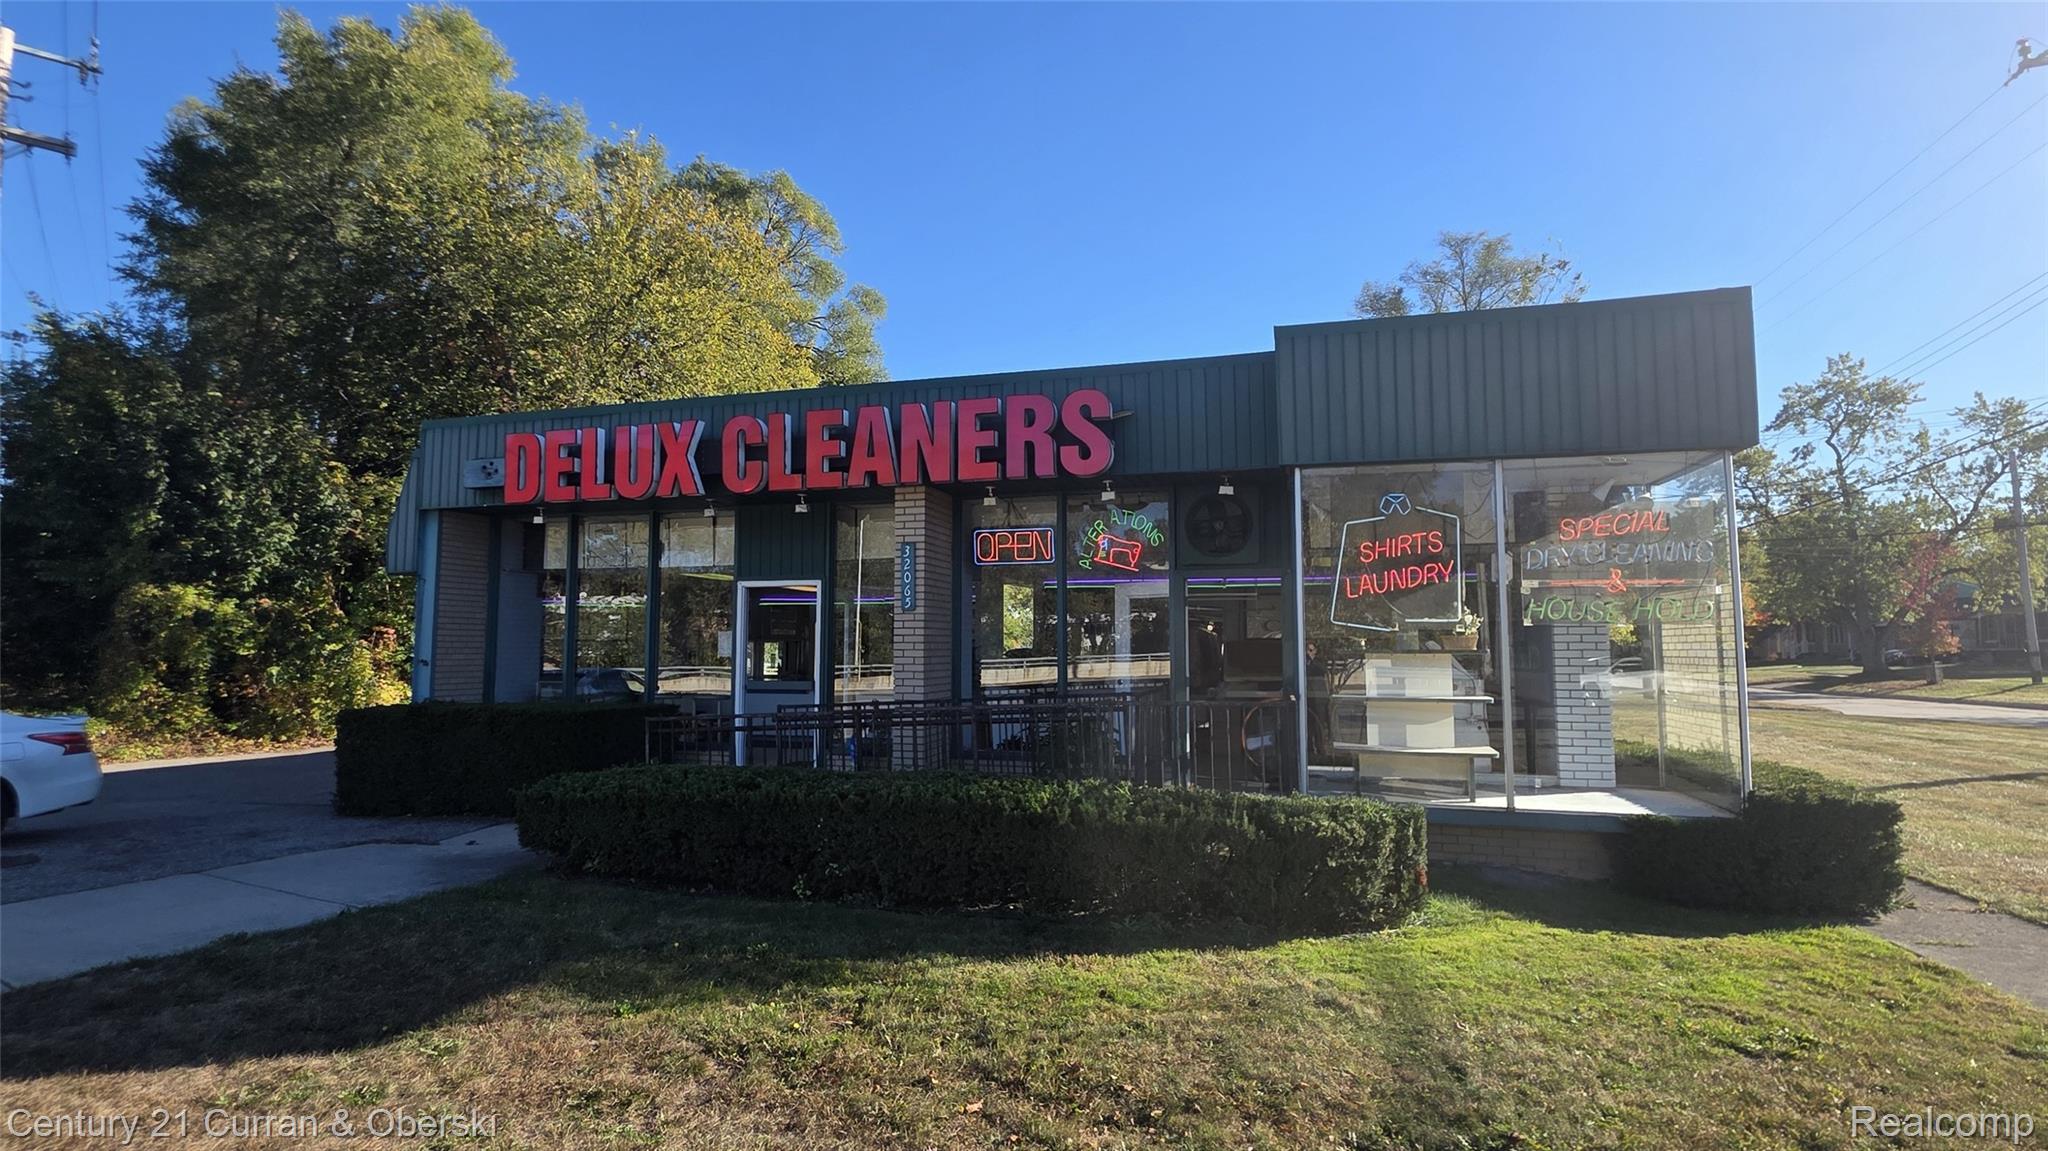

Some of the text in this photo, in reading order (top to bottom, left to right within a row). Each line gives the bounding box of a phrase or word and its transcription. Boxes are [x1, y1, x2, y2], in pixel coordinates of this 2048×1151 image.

[504, 388, 1116, 505] DELUX CLEANERS
[1559, 509, 1670, 542] SPECIAL
[977, 530, 1052, 562] OPEN
[1360, 531, 1443, 563] SHIRTS
[1526, 539, 1714, 571] DRY CLEANING
[902, 545, 912, 608] 32065
[1345, 559, 1454, 599] LAUNDRY
[1607, 568, 1627, 593] &
[1526, 597, 1714, 622] HOUSE HOLD
